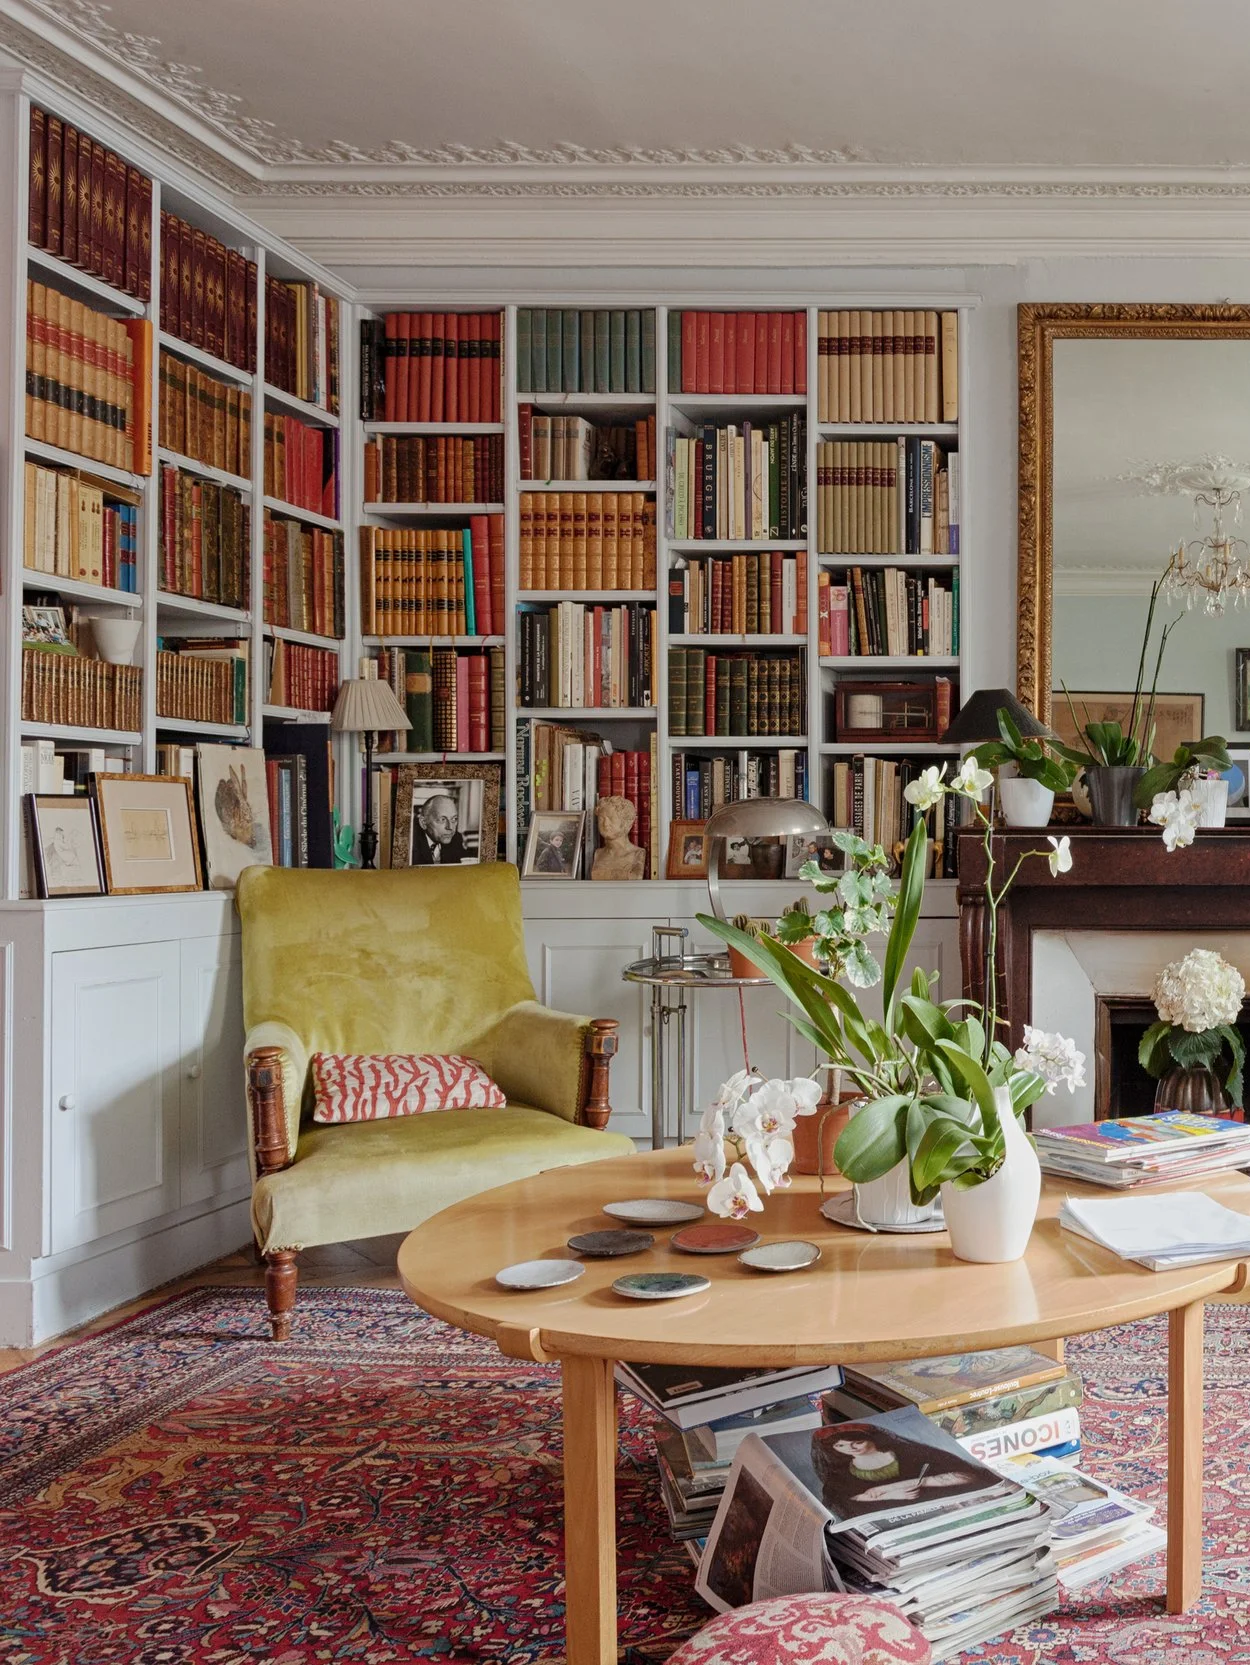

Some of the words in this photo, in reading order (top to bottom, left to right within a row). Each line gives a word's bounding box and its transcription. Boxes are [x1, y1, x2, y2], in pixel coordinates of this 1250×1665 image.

[705, 444, 713, 512] BRUEGEL
[922, 444, 932, 519] L'IMPRESSIONNISME
[516, 722, 530, 774] Norman
[854, 772, 863, 790] PARIS
[854, 791, 863, 799] DE
[299, 784, 308, 816] Cinéma
[516, 774, 530, 835] Rockwell
[300, 817, 308, 827] du
[300, 829, 308, 853] Siècle
[301, 853, 308, 864] Le
[971, 1421, 1060, 1460] ICONES
